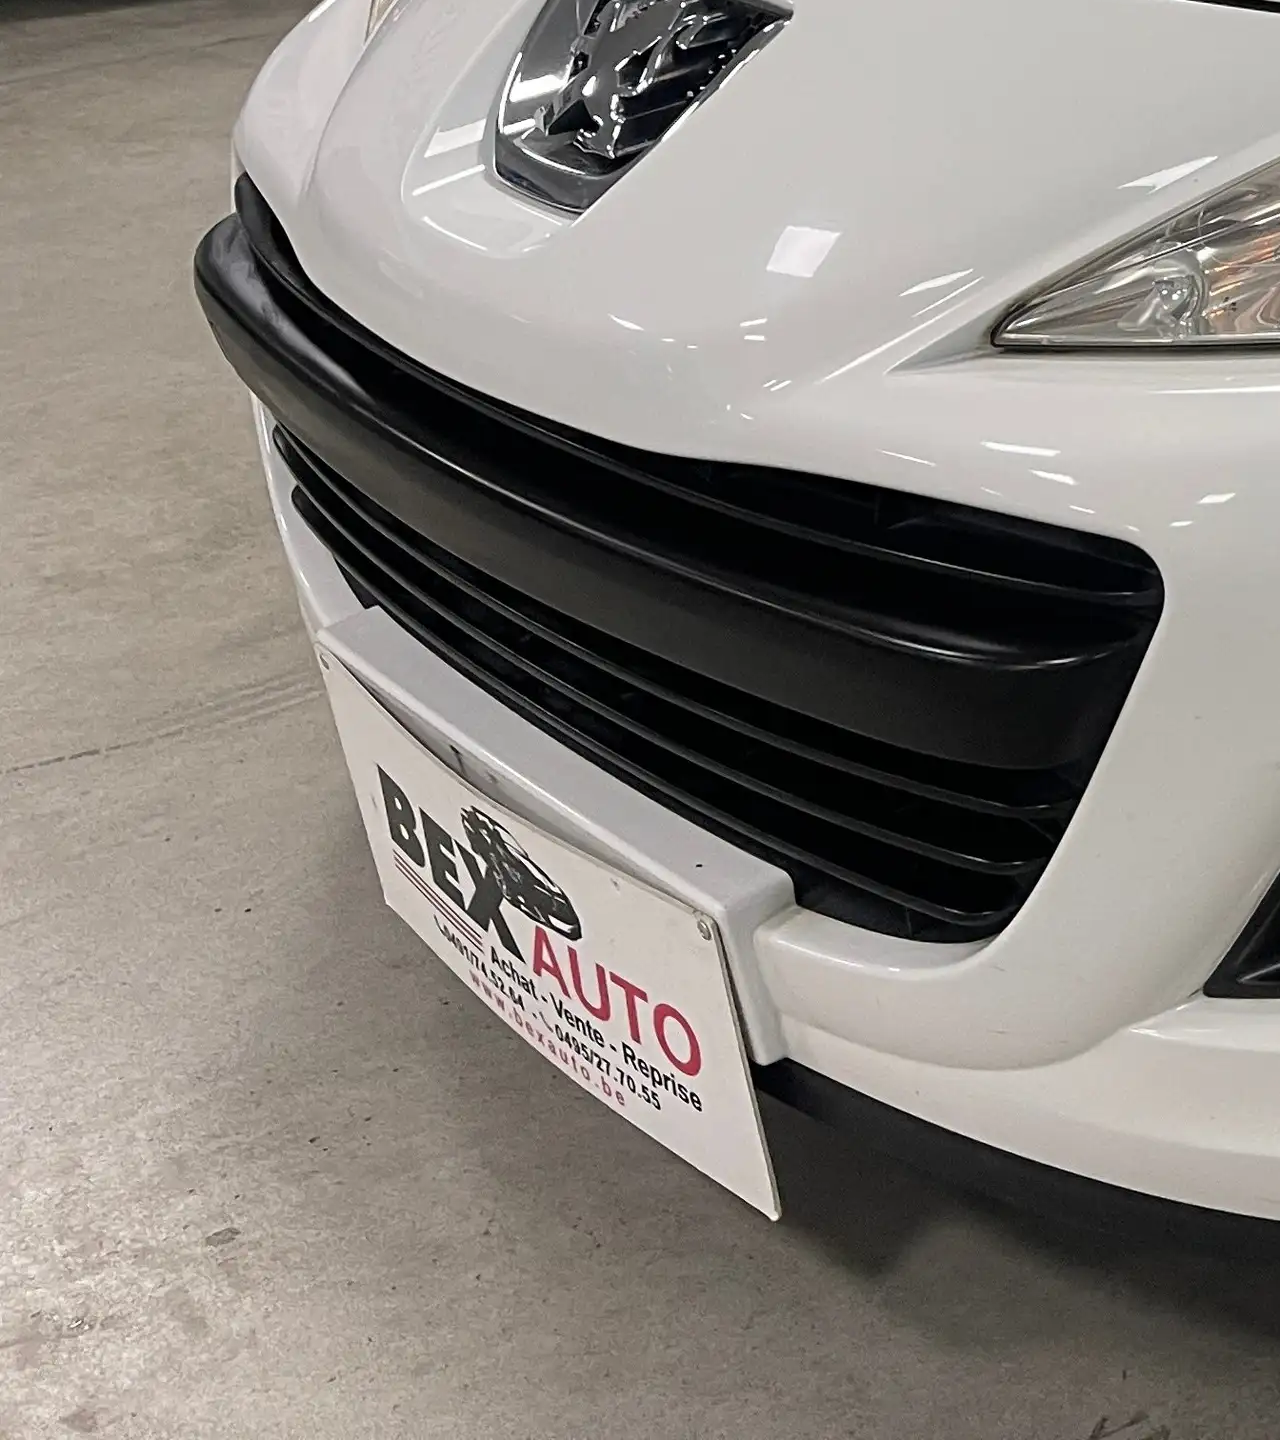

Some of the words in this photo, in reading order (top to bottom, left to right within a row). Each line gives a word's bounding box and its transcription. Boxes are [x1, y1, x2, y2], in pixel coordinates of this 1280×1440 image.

[377, 763, 526, 964] BEX
[533, 925, 701, 1077] AUTO
[490, 946, 539, 1001] Achat
[549, 992, 605, 1048] Vente
[621, 1041, 703, 1112] Reprise
